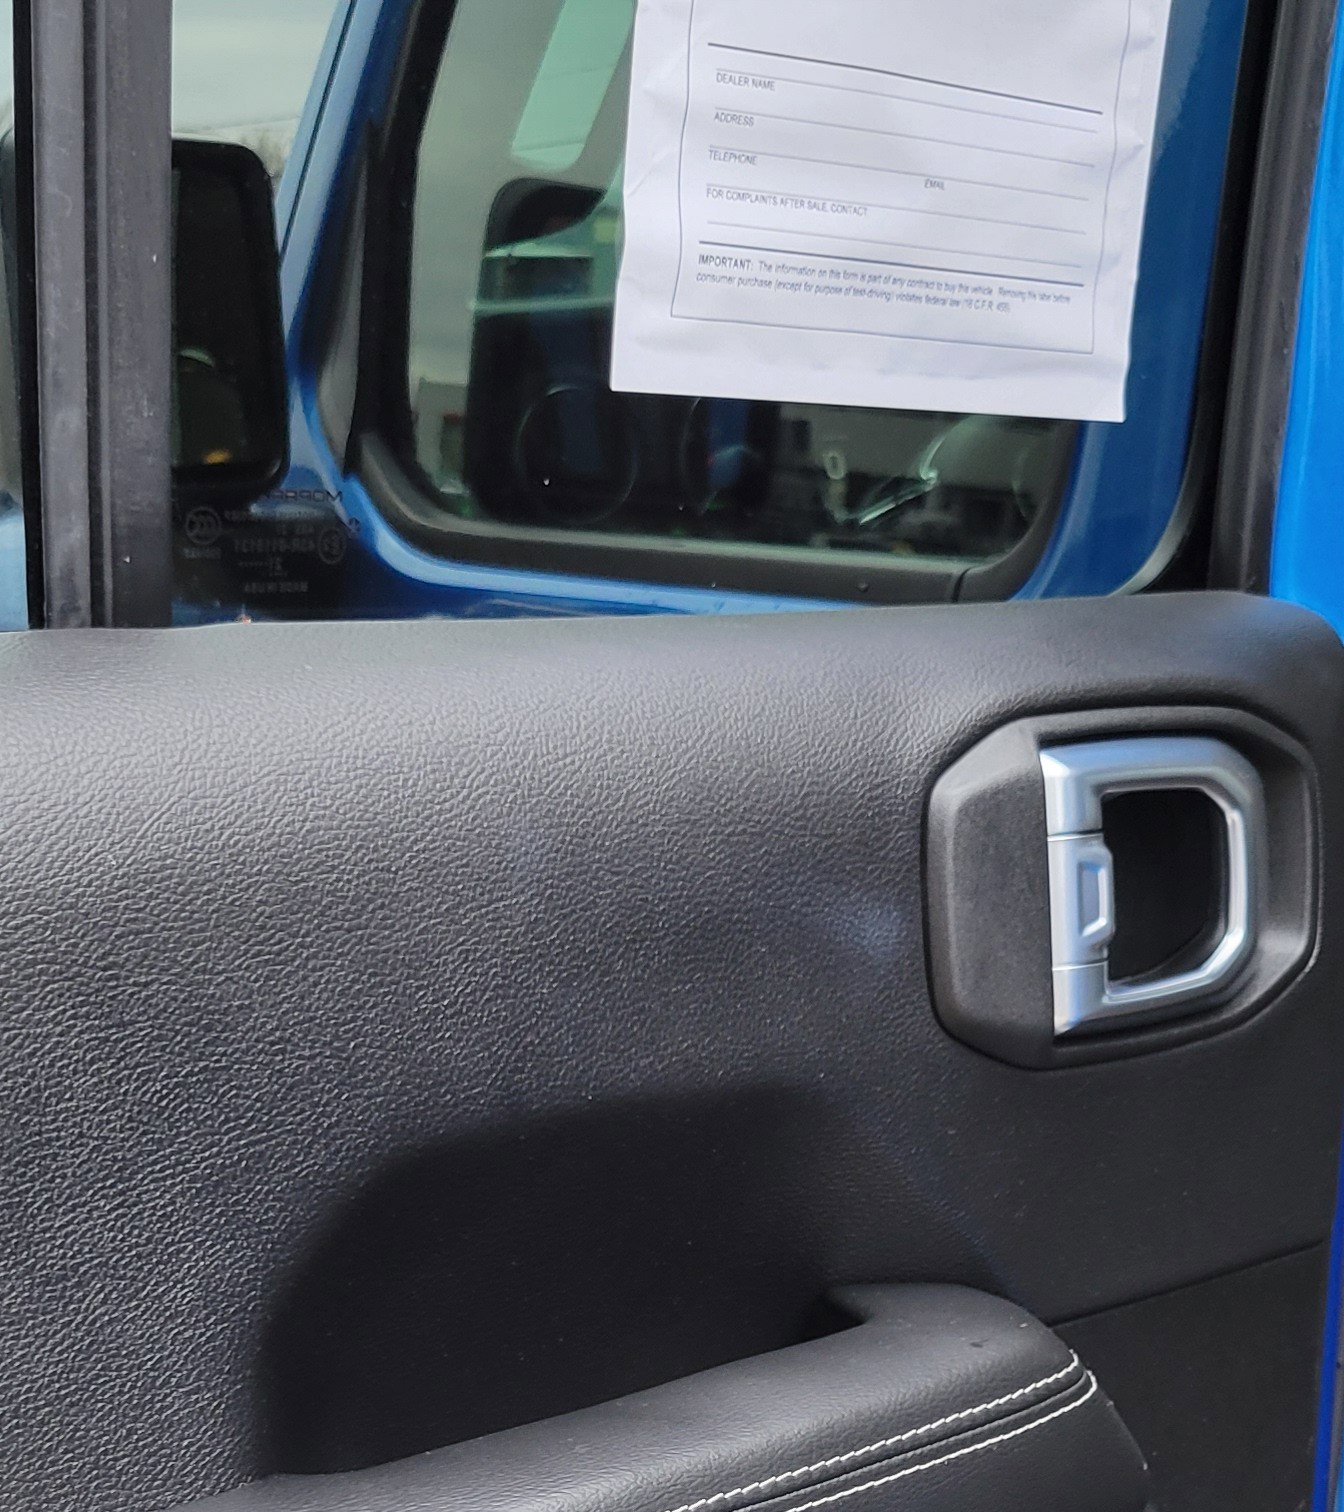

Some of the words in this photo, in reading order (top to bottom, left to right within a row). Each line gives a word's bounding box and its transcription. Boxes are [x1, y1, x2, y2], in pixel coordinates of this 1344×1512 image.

[716, 72, 750, 87] DEALER
[752, 78, 775, 91] NAME
[714, 112, 754, 127] ADDRESS
[709, 149, 757, 165] TELEPHONE
[924, 178, 946, 190] EMAIL
[706, 187, 724, 199] FOR
[726, 190, 778, 206] COMPLAINTS
[780, 197, 805, 210] AFTER
[698, 254, 753, 271] IMPORTANT:
[758, 260, 773, 273] The
[775, 263, 815, 277] information
[818, 268, 827, 278] on
[843, 269, 858, 280] form
[696, 272, 736, 285] consumer
[737, 276, 772, 289] purchase
